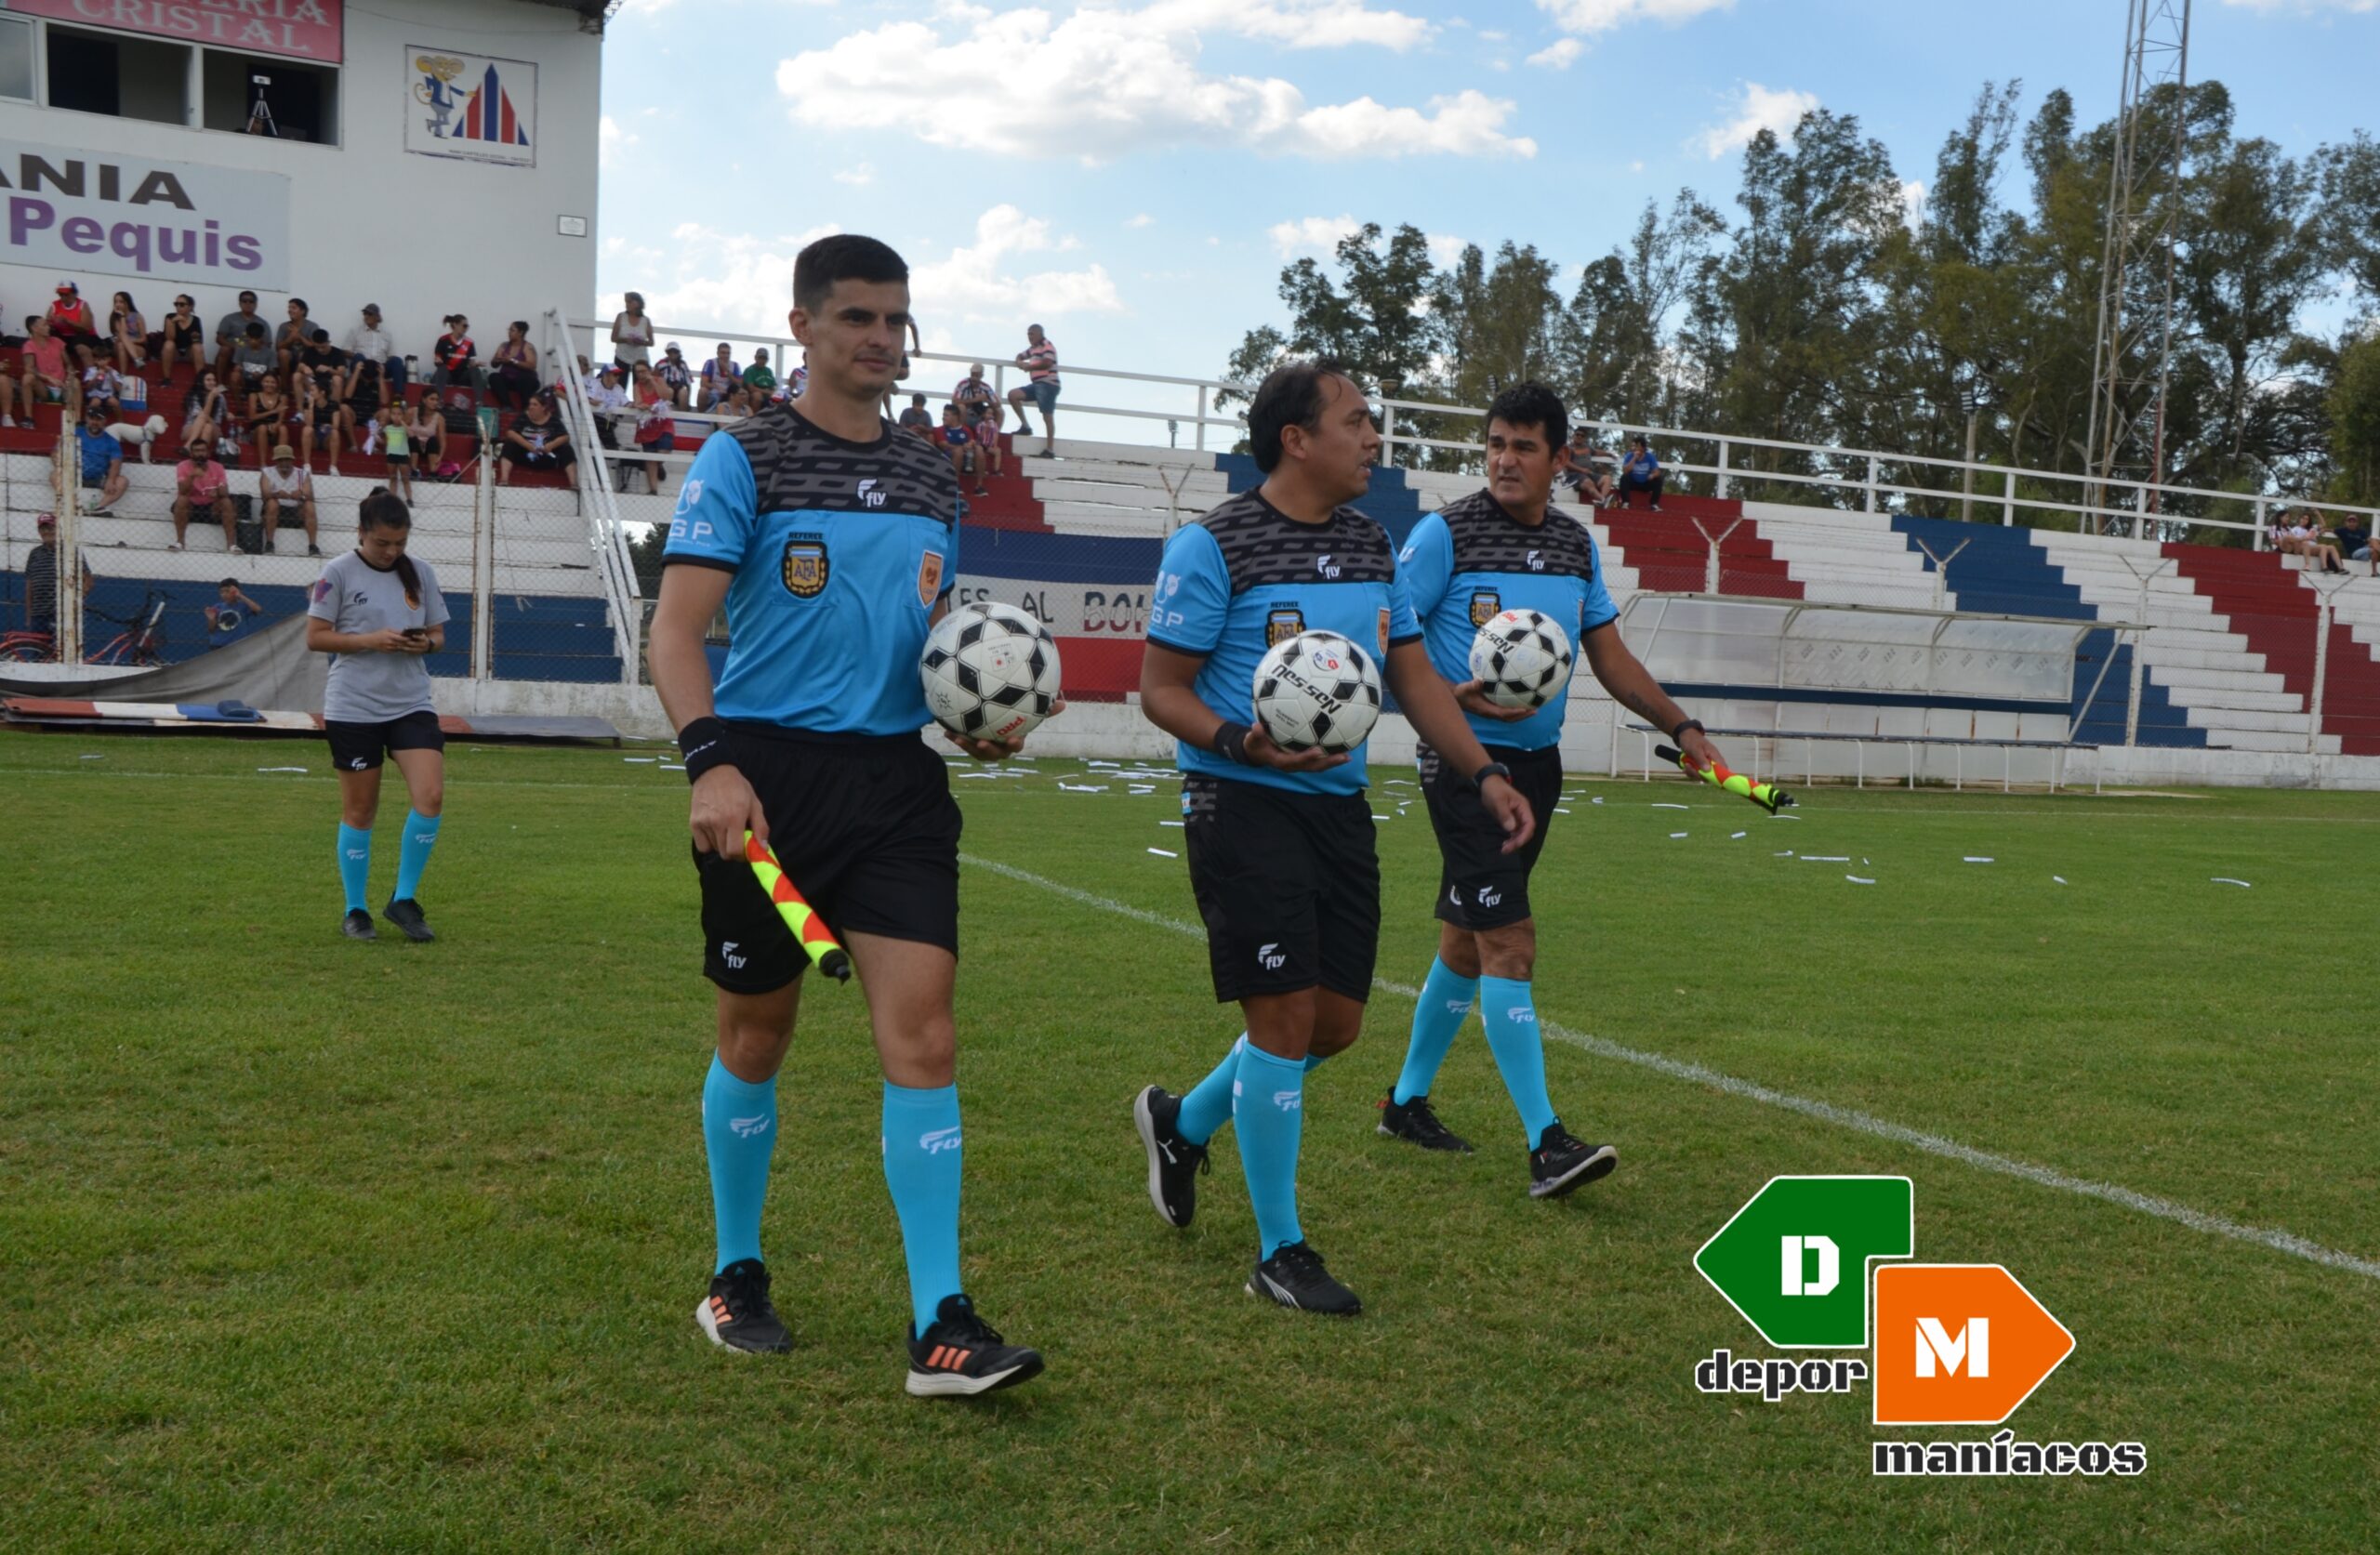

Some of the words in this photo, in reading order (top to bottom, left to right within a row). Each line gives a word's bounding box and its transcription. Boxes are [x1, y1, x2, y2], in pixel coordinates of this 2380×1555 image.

[73, 0, 311, 53] CRISTAL
[0, 153, 196, 211] NIA
[9, 196, 263, 272] Pequis
[1023, 591, 1054, 623] AL
[997, 716, 1025, 735] PRO
